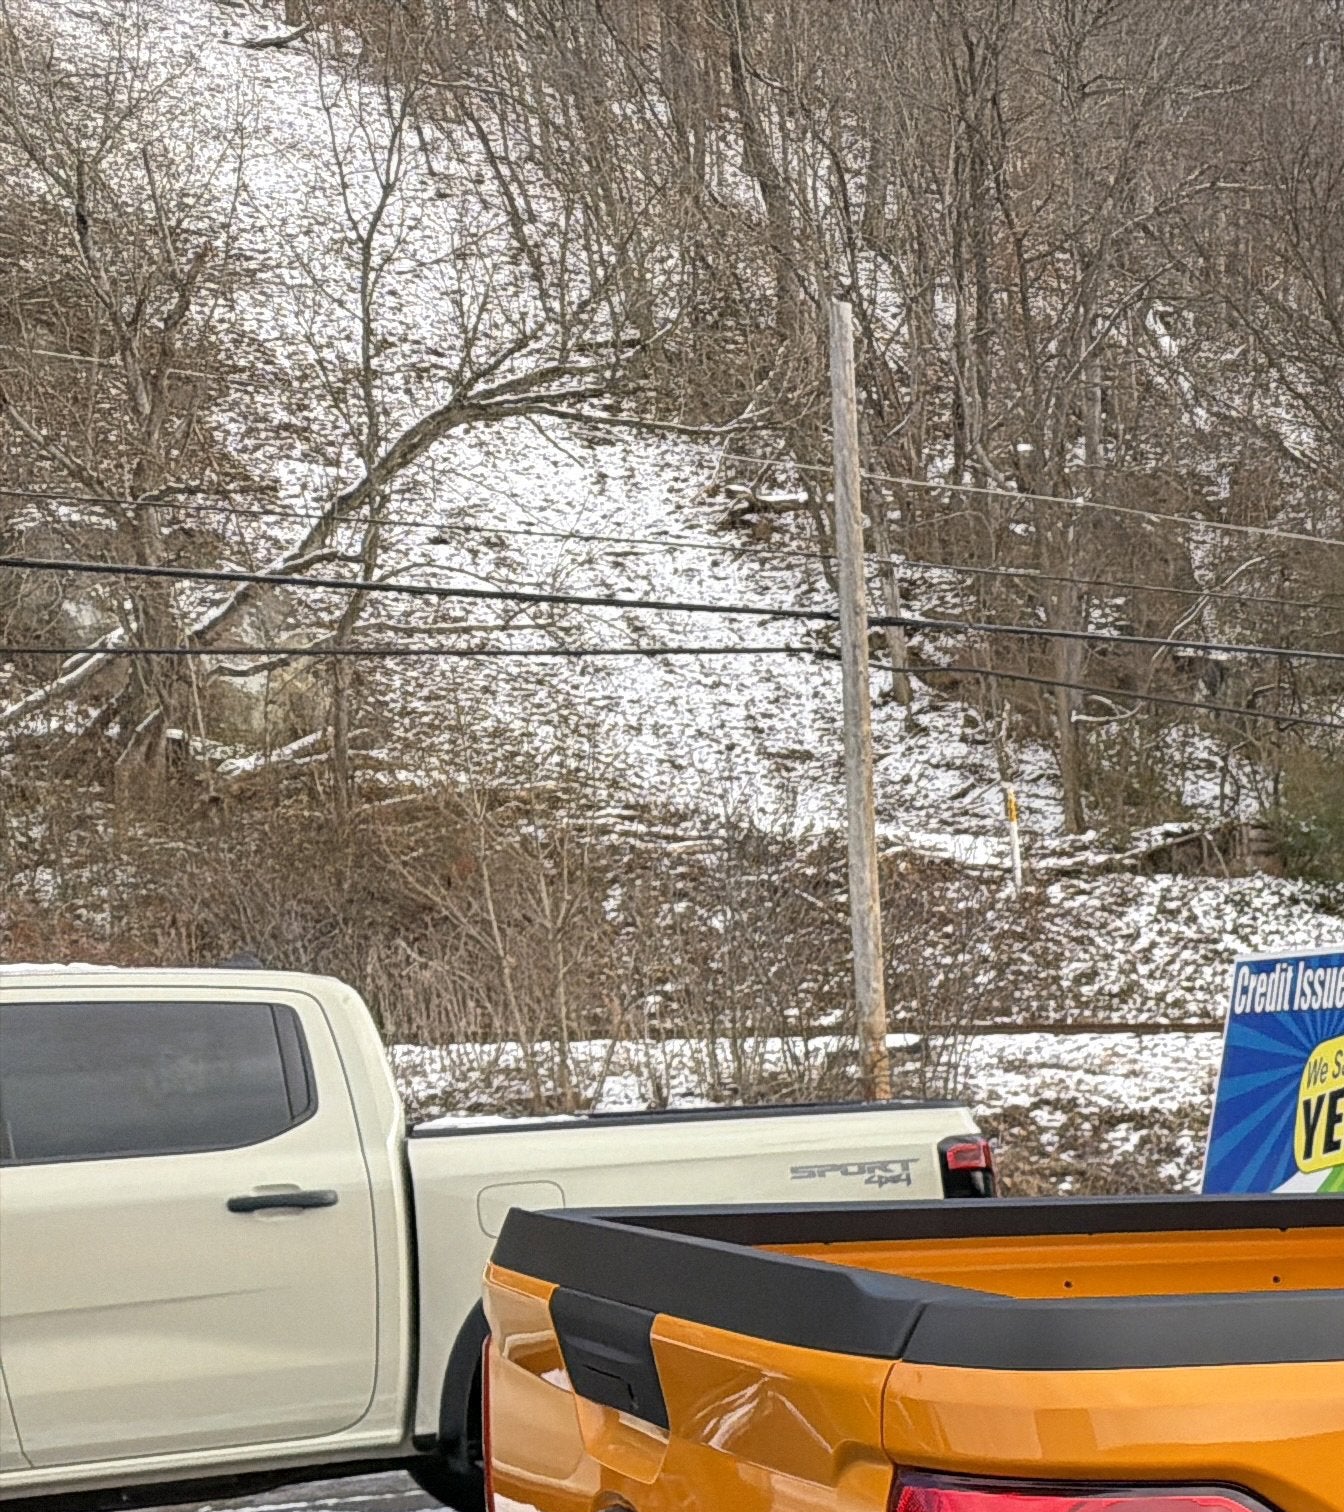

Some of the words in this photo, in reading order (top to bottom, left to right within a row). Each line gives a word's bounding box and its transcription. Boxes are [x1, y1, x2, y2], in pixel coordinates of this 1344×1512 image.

[1233, 961, 1293, 1015] Credit
[1307, 1058, 1329, 1089] We
[790, 1158, 920, 1180] SPORT
